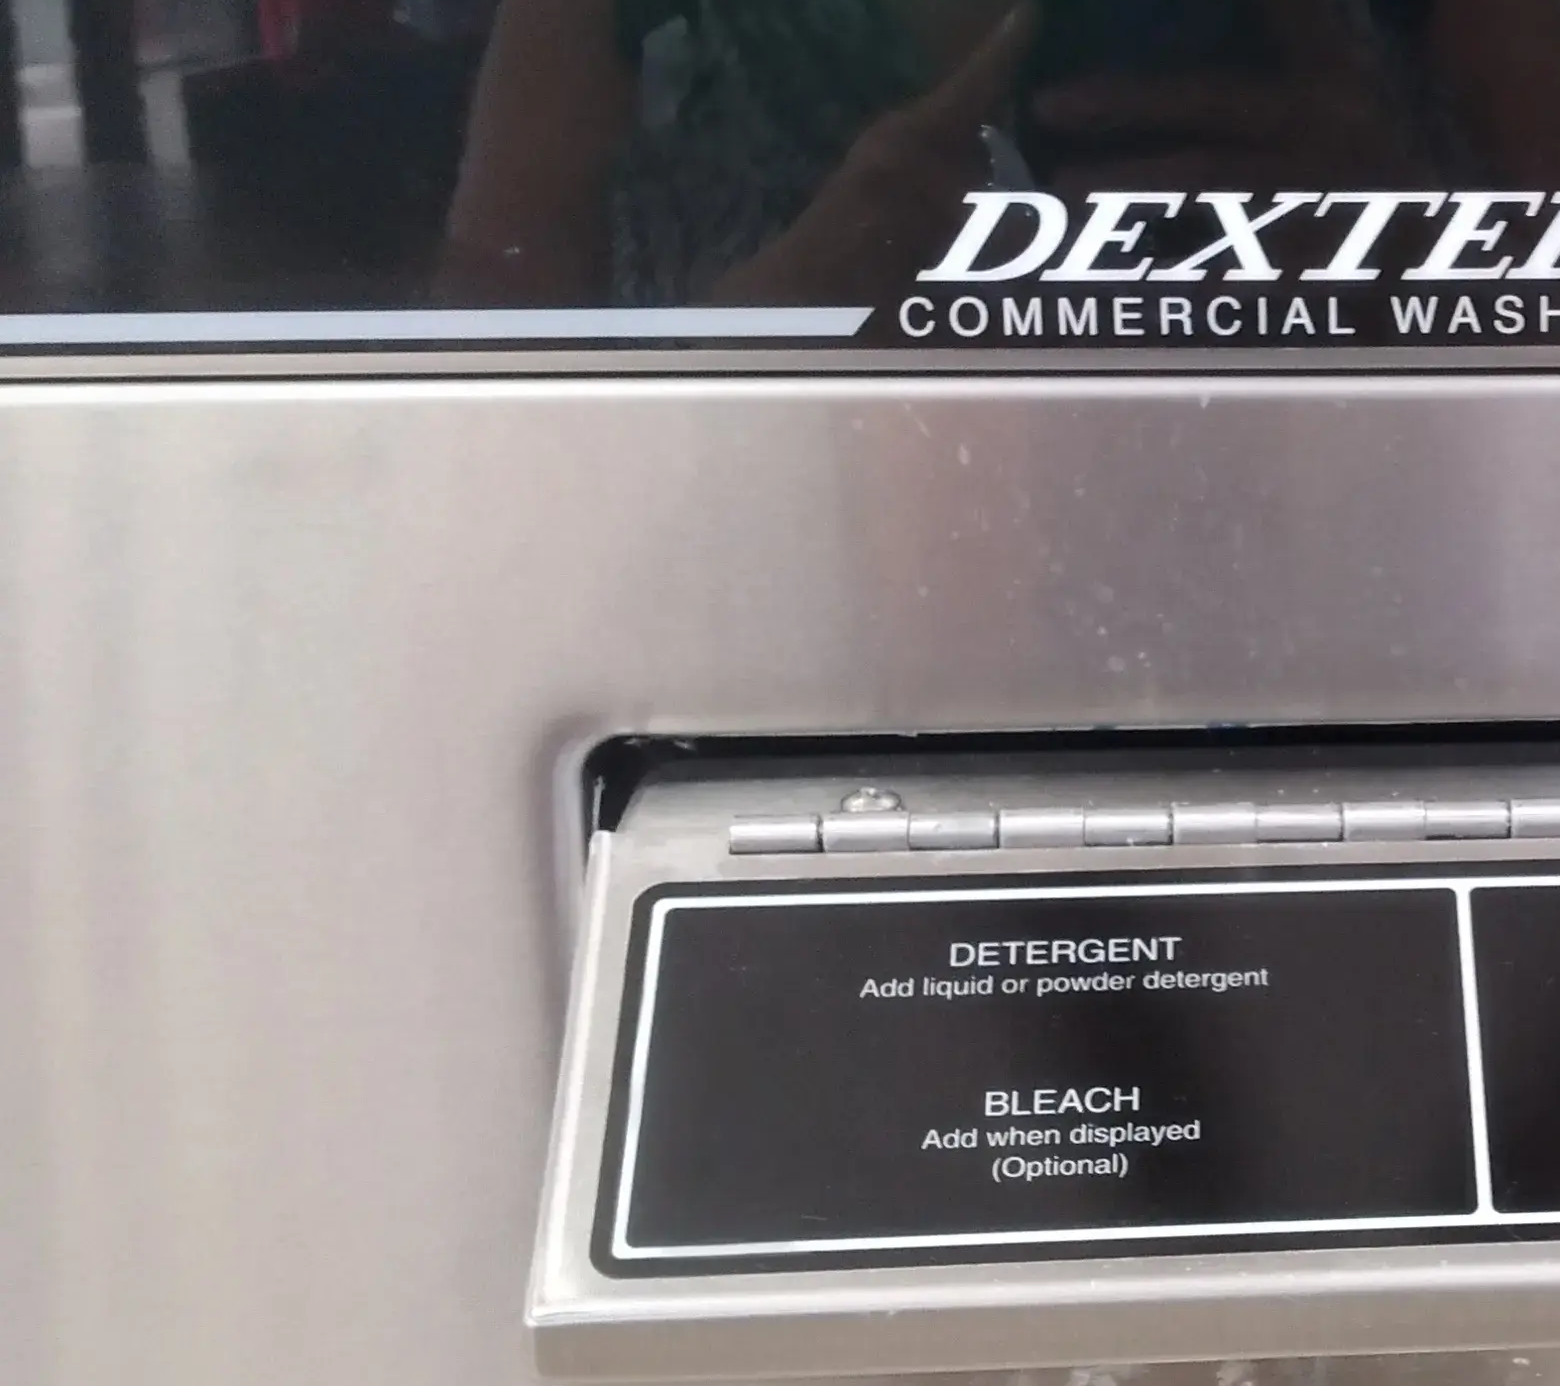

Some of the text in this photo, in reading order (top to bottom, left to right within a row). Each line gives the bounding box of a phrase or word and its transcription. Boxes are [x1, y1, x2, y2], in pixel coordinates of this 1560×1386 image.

[898, 295, 1356, 338] COMMERCIAL
[949, 936, 1182, 968] DETERGENT
[859, 967, 1270, 1001] Add liquid or powder detergent
[984, 1086, 1141, 1117] BLEACH
[920, 1119, 1201, 1150] Add when displayed
[991, 1152, 1129, 1183] (Optional)
